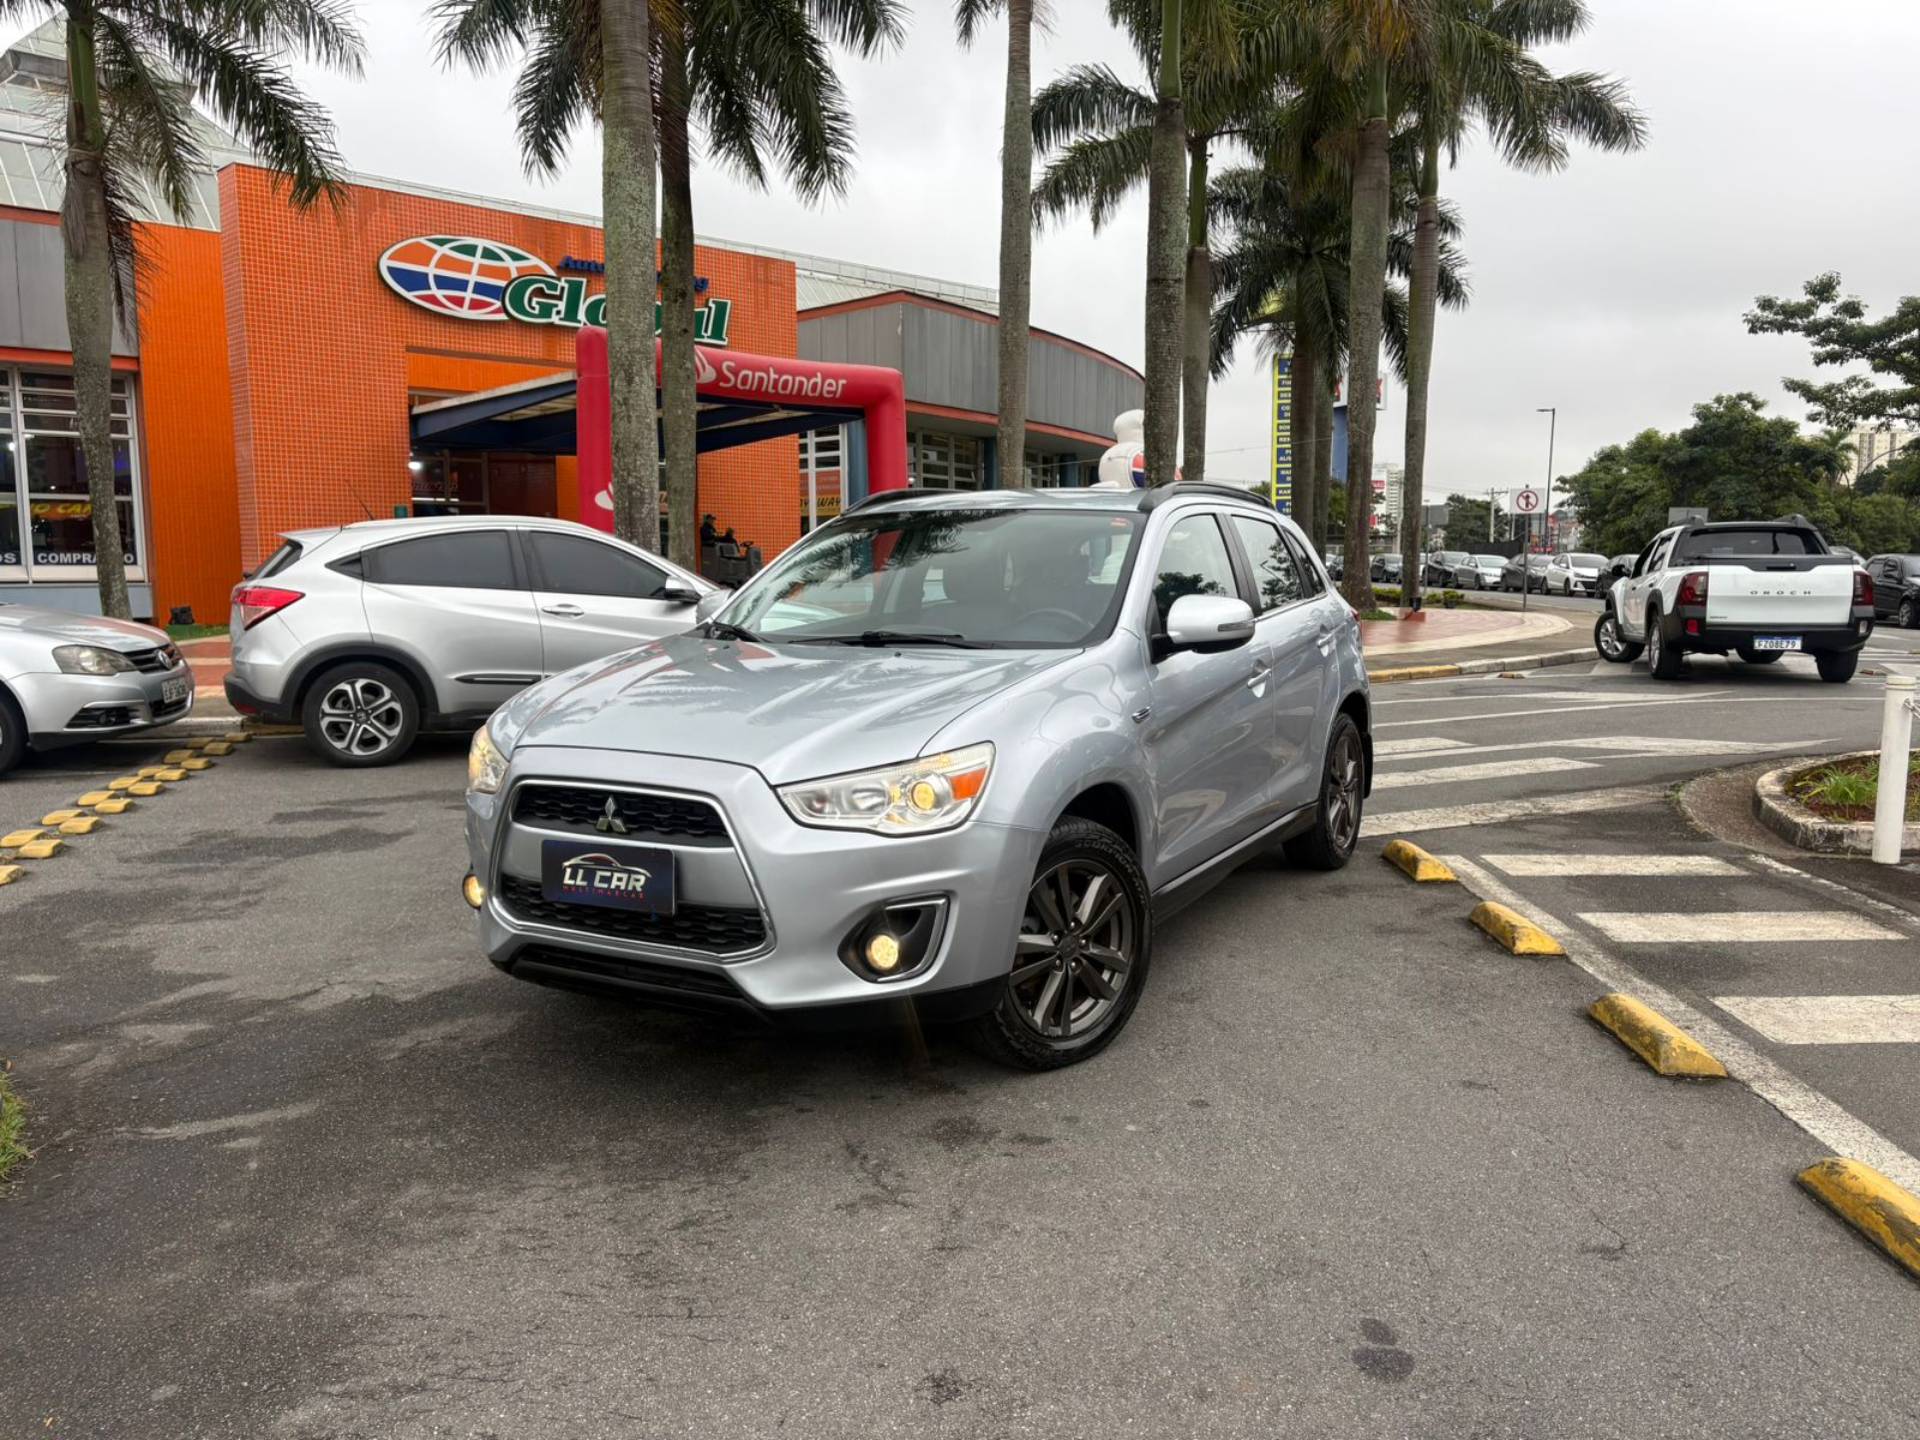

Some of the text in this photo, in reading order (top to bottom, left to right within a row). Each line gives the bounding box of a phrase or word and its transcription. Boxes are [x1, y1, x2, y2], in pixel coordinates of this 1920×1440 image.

[719, 361, 847, 398] Santander
[563, 868, 646, 892] LL CAR
